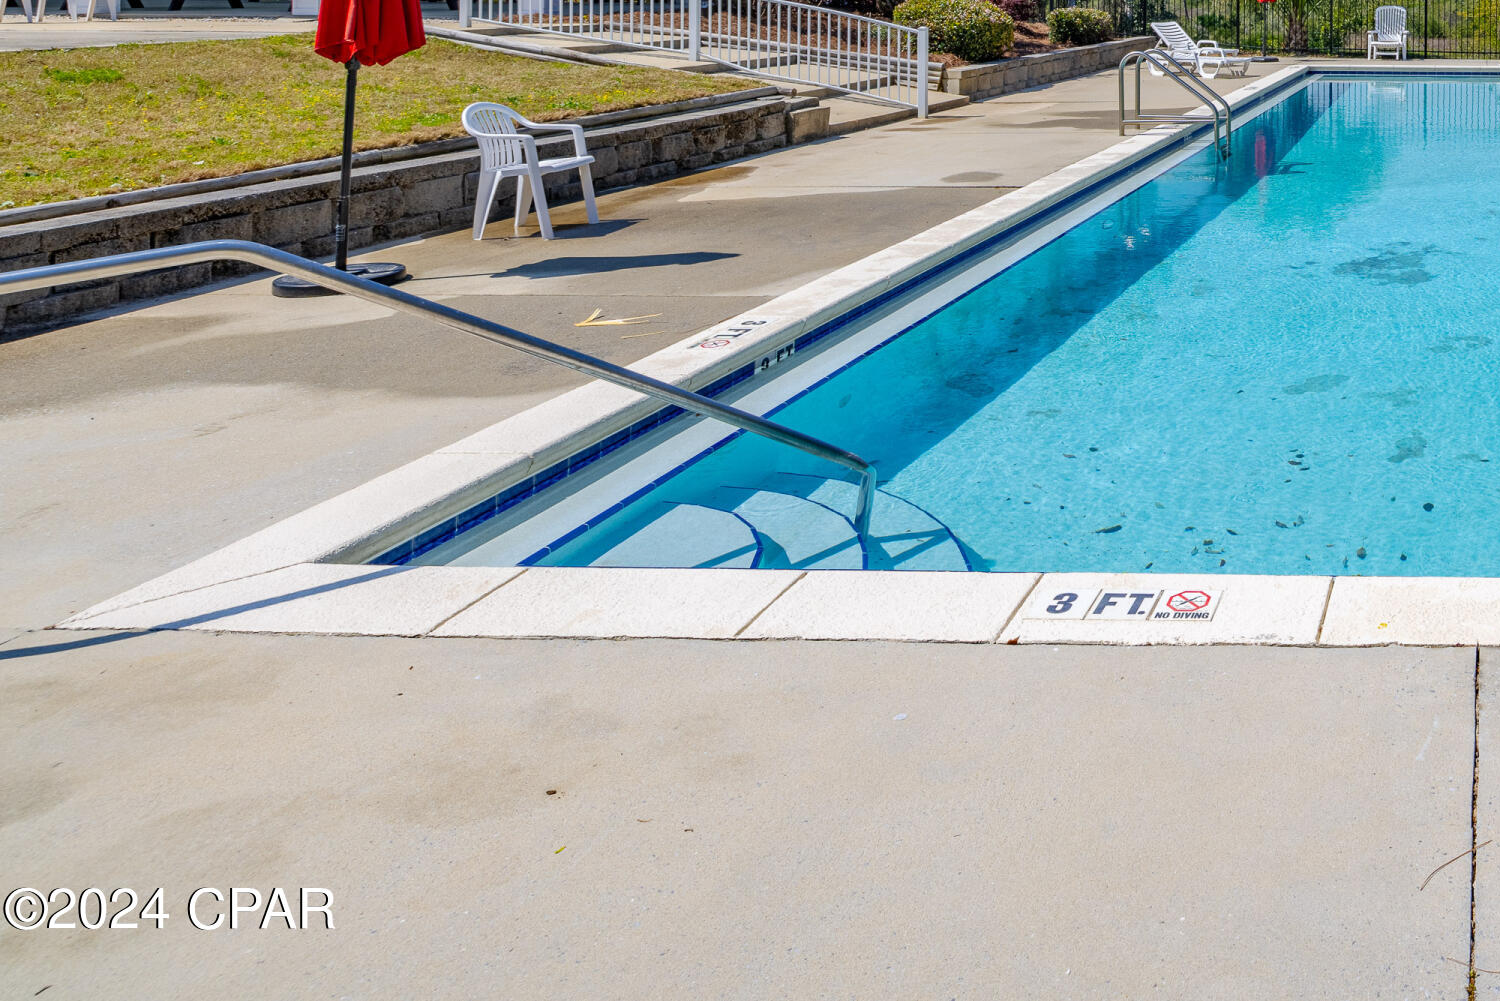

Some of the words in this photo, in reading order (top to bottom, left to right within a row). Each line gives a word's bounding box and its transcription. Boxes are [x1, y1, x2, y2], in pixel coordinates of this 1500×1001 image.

[1046, 592, 1079, 615] 3
[1093, 593, 1154, 615] FT.
[1154, 611, 1170, 619] NO
[1173, 611, 1210, 619] DIVING
